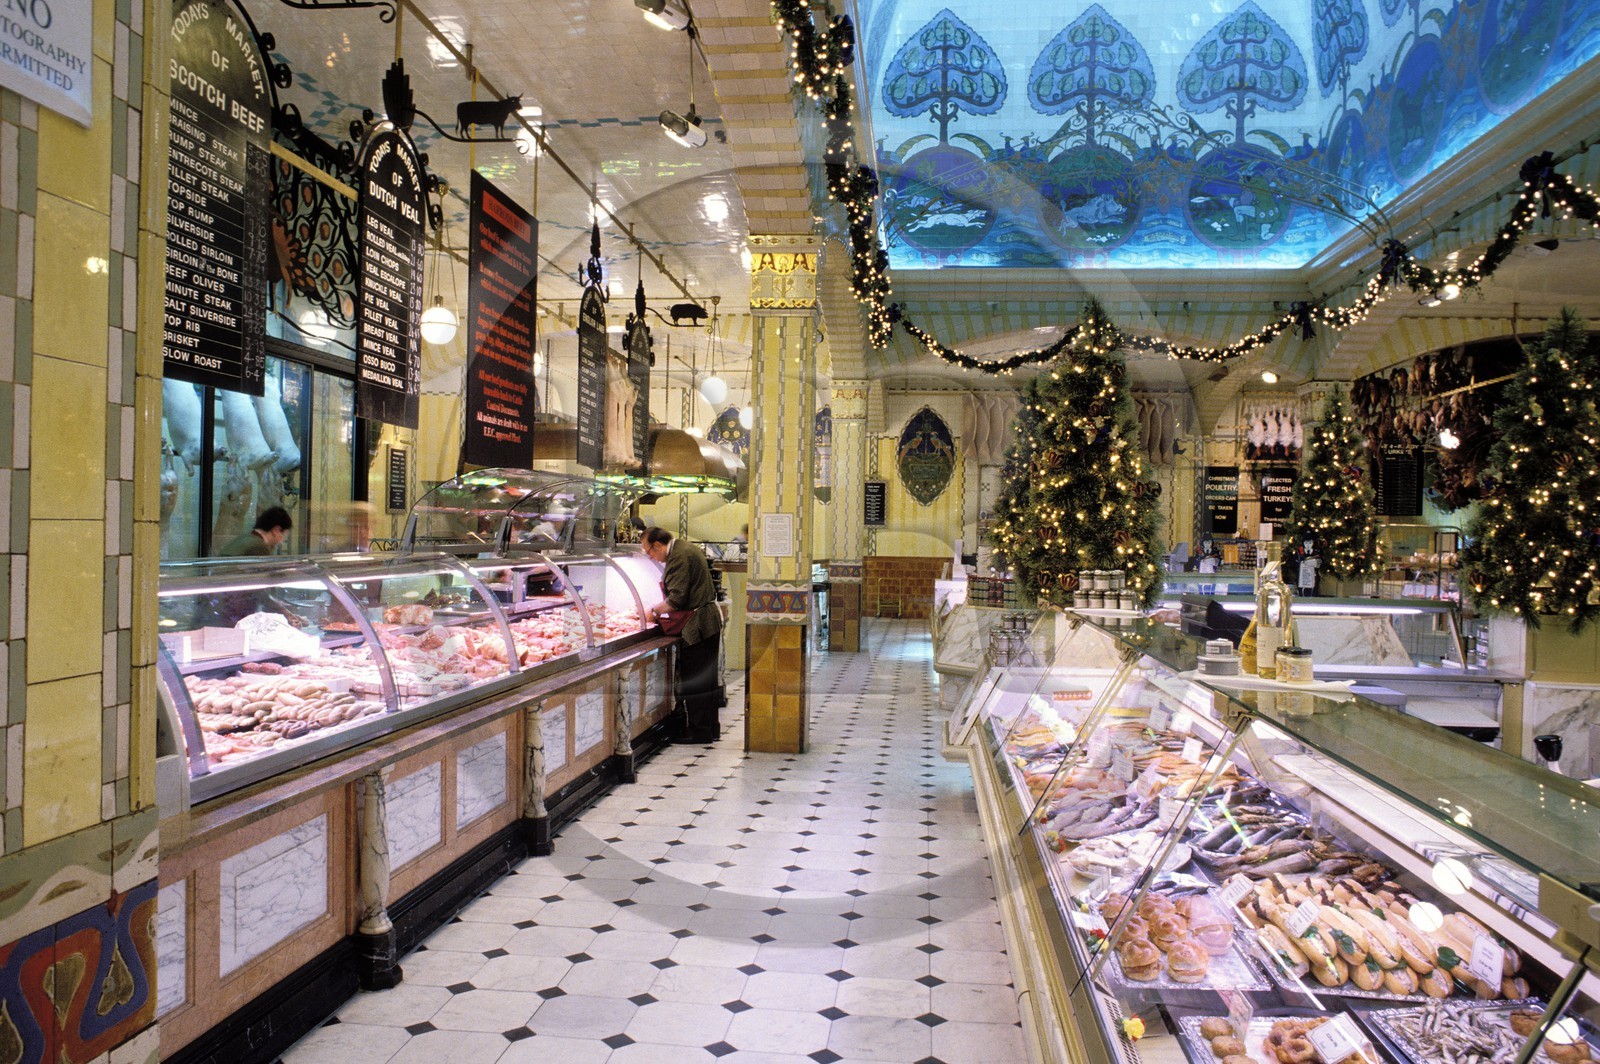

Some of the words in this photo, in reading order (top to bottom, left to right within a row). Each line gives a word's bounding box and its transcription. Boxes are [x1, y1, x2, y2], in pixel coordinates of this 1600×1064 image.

[171, 2, 210, 42] TODAYS
[0, 42, 73, 91] RMITTED
[211, 50, 230, 72] OF
[170, 58, 226, 111] SCOTCH
[231, 99, 265, 134] BEEF
[170, 98, 199, 122] MINCE
[198, 147, 227, 170] STEAK
[212, 139, 238, 162] STEAK
[369, 140, 391, 174] TODAYS
[168, 163, 198, 186] FILLET
[201, 181, 230, 203] STEAK
[219, 174, 244, 195] STEAK
[391, 171, 403, 187] OF
[168, 179, 207, 207] TOPSIDE
[369, 180, 397, 210] DUTCH
[401, 201, 420, 225] VEAL
[168, 196, 186, 211] TOP
[188, 206, 215, 226] RUMP
[167, 212, 215, 243] SILVERSIDE
[366, 214, 379, 229] LEG
[379, 222, 395, 240] VEAL
[201, 245, 234, 266] SIRLOIN
[366, 230, 386, 249] ROLLED
[385, 241, 398, 256] VEAL
[166, 246, 199, 269] SIRLOIN
[216, 266, 239, 283] BONE
[365, 245, 380, 261] LOIN
[380, 255, 400, 272] CHOPS
[166, 263, 188, 280] BEEF
[192, 274, 225, 294] OLIVES
[365, 261, 380, 277] VEAL
[380, 269, 406, 290] ESCALOPE
[166, 281, 199, 300] MINUTE
[204, 294, 232, 311] STEAK
[364, 292, 374, 304] PIE
[376, 297, 390, 311] VEAL
[365, 276, 388, 295] KNUCKLE
[389, 288, 403, 303] VEAL
[165, 296, 187, 313] SALT
[189, 305, 237, 328] SILVERSIDE
[165, 313, 182, 327] TOP
[185, 320, 201, 333] RIB
[364, 307, 383, 323] FILLET
[384, 316, 399, 330] VEAL
[164, 330, 200, 348] BRISKET
[363, 322, 385, 339] BREAST
[385, 331, 400, 344] VEAL
[162, 346, 190, 362] SLOW
[194, 354, 222, 370] ROAST
[363, 338, 381, 353] MINCE
[382, 345, 396, 358] VEAL
[363, 354, 379, 367] OSSO
[380, 359, 396, 373] BUCO
[392, 377, 404, 389] VEAL
[1267, 485, 1292, 493] FRESH
